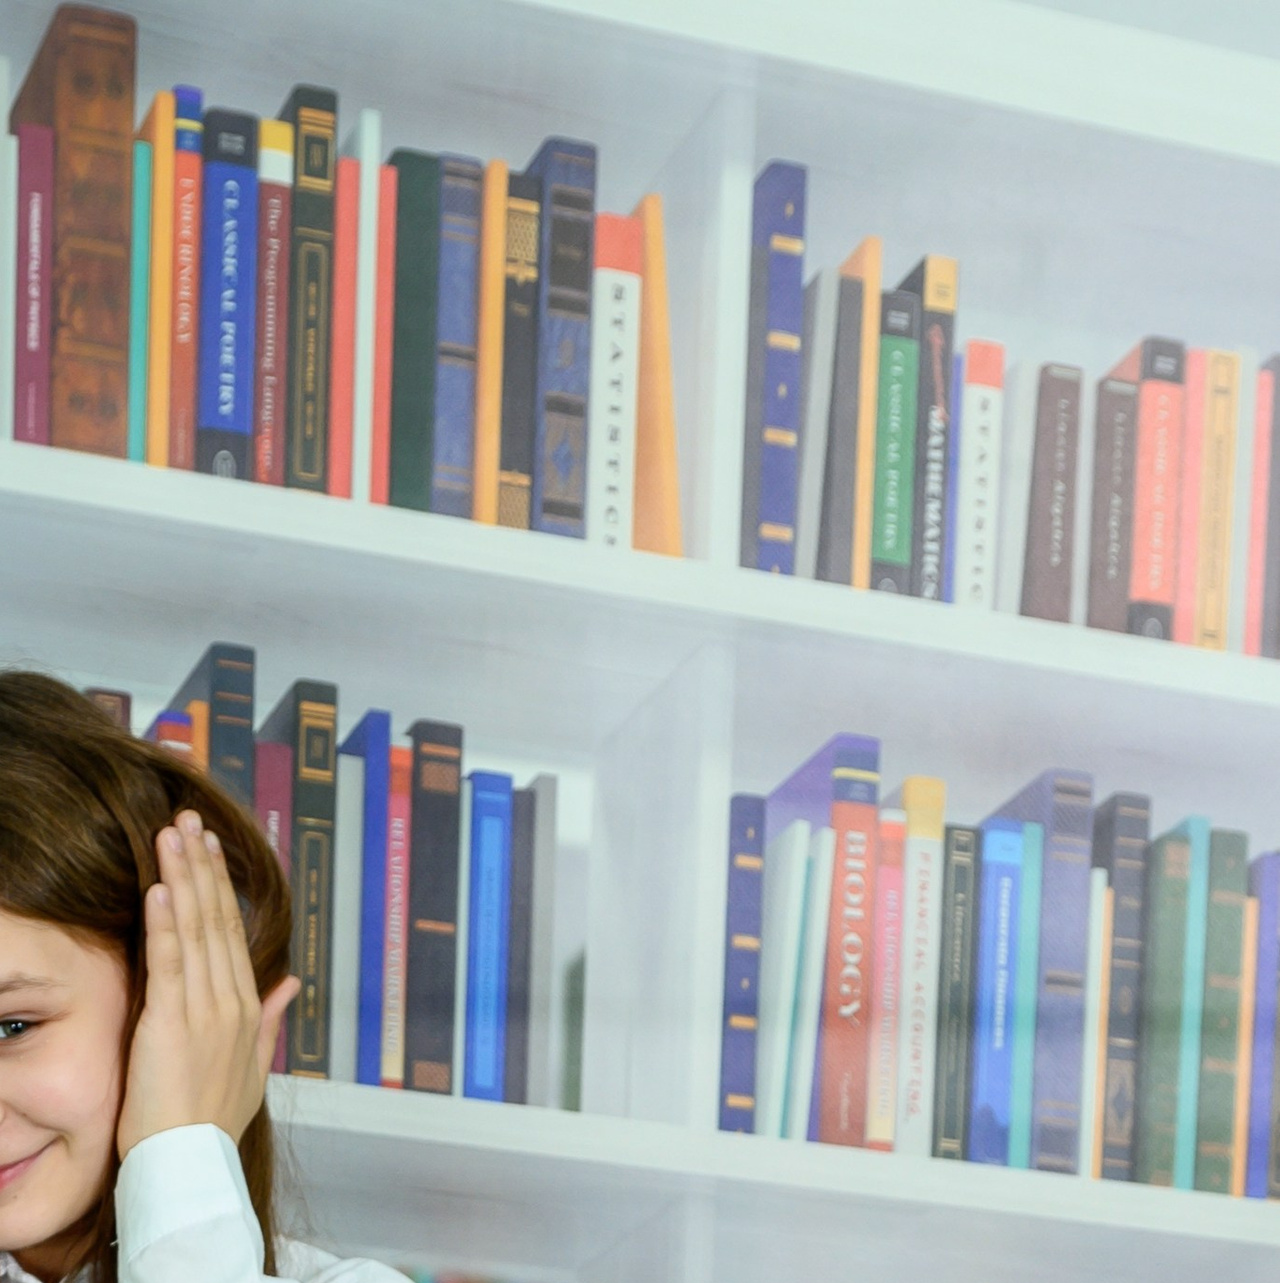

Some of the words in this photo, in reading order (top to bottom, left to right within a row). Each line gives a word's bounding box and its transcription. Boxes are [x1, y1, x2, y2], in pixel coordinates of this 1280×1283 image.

[219, 179, 240, 314] CLASSICAL
[218, 320, 236, 416] POETRY
[922, 404, 947, 599] MATHEMATICS
[837, 829, 867, 1027] BIOLOGY
